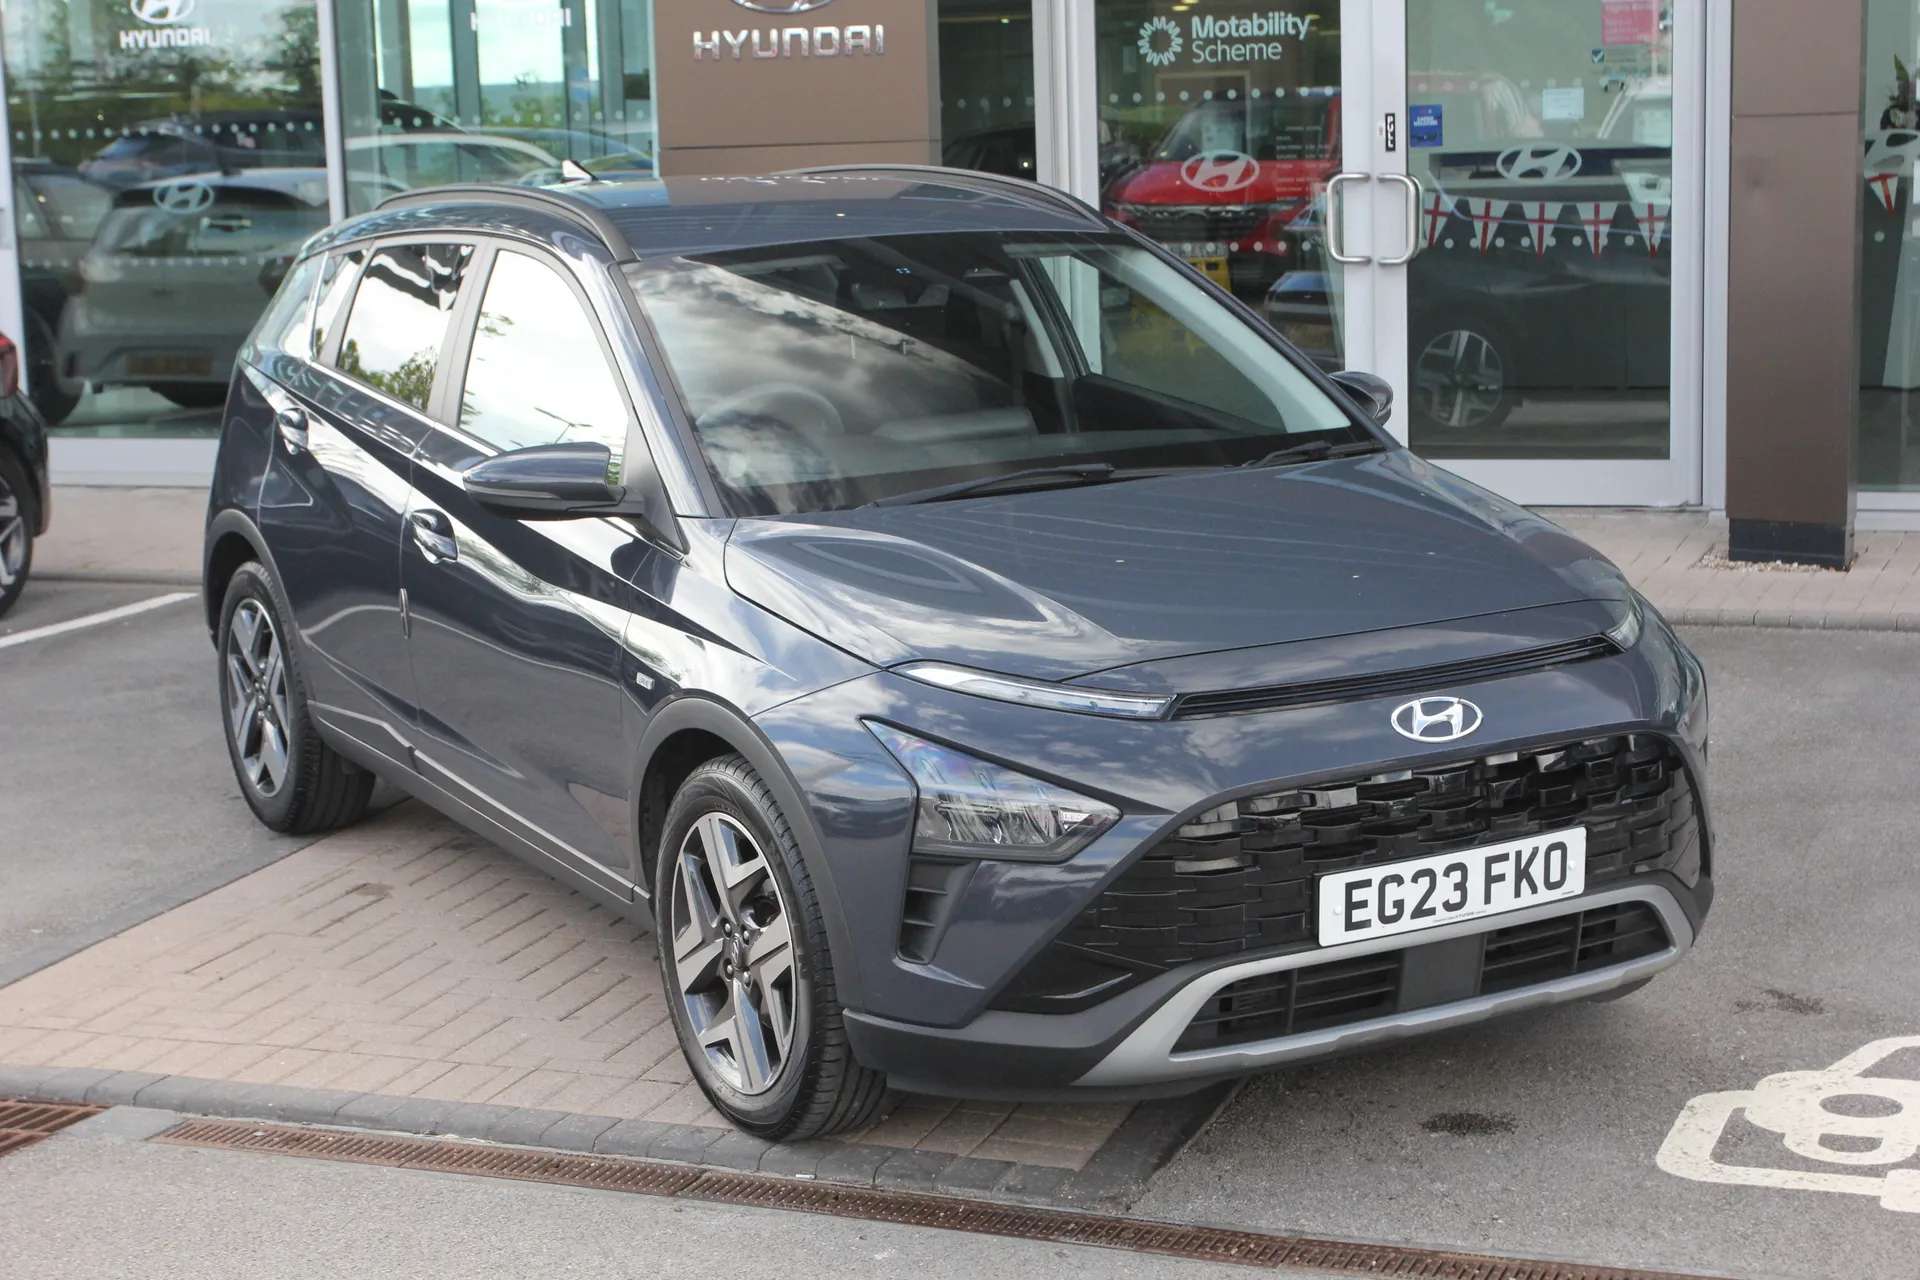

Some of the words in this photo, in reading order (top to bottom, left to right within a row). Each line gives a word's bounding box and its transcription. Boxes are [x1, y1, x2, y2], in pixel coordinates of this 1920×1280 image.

[119, 27, 211, 49] HYUNDAI
[1191, 11, 1312, 40] Motability
[693, 24, 885, 60] HYUNDAI
[1191, 40, 1282, 64] Scheme
[1344, 861, 1469, 932] EG23
[1484, 841, 1569, 905] FKO
